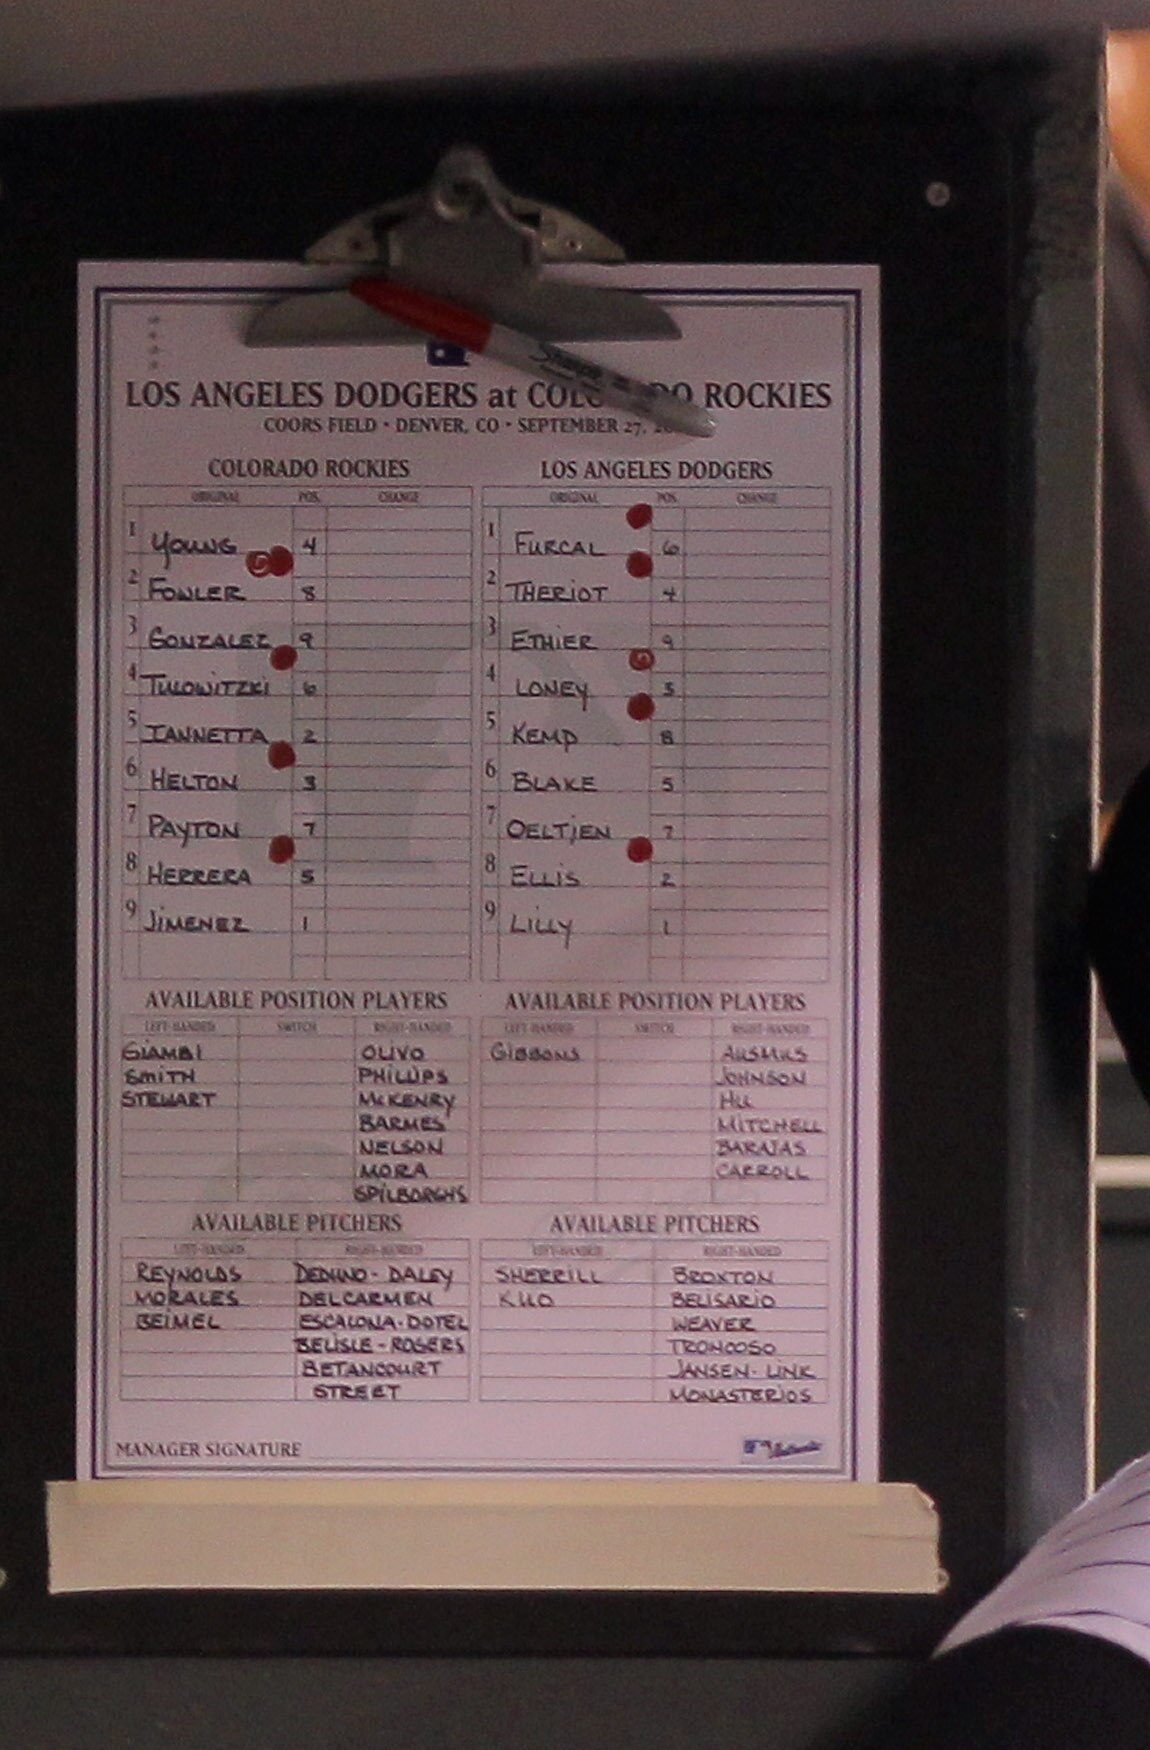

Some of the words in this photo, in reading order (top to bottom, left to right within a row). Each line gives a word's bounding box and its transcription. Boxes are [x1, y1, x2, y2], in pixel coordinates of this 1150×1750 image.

[126, 381, 180, 409] LOS
[190, 381, 325, 409] ANGELES
[334, 381, 479, 409] DODGERS
[488, 384, 518, 409] at
[527, 381, 694, 409] COLODO
[704, 381, 833, 410] ROCKIES
[264, 417, 323, 433] COORS
[328, 417, 378, 433] FIELD
[394, 417, 469, 436] DENVER,
[475, 418, 500, 434] CO
[518, 418, 619, 434] SEPTEMBER
[208, 458, 318, 479] COLORADO
[325, 458, 410, 479] ROCKIES
[540, 460, 578, 479] LOS
[583, 460, 671, 480] ANGELES
[678, 460, 773, 480] DODGERS
[128, 521, 137, 538] 1
[487, 521, 495, 538] 1
[151, 532, 239, 569] YOUNG
[302, 537, 317, 555] 4
[515, 531, 607, 555] FURCAL
[661, 540, 680, 556] 6
[127, 570, 139, 585] 2
[486, 571, 497, 585] 2
[148, 577, 246, 602] FOWLER
[301, 586, 316, 602] 8
[505, 579, 609, 602] THERIOT
[661, 586, 677, 602] 4
[128, 616, 138, 635] 3
[487, 617, 497, 635] 3
[148, 626, 271, 650] GONZALEZ
[299, 634, 314, 651] 9
[511, 625, 599, 650] ETHIER
[661, 634, 675, 650] 9
[127, 663, 138, 681] 4
[485, 663, 496, 682] 4
[303, 680, 317, 696] 6
[516, 678, 590, 712] LONEY
[127, 711, 138, 728] 5
[485, 711, 497, 729] 5
[140, 724, 271, 744] IANNETTA
[302, 729, 318, 744] 2
[511, 722, 579, 752] KEMP
[126, 758, 138, 777] 6
[484, 759, 496, 778] 6
[151, 768, 240, 791] HELTON
[302, 776, 317, 792] 3
[511, 771, 599, 792] BLAKE
[661, 777, 675, 792] 5
[126, 804, 137, 822] 7
[485, 805, 497, 823] 7
[148, 814, 241, 849] PAYTON
[302, 822, 317, 837] 7
[662, 825, 674, 840] 7
[125, 852, 137, 871] 8
[484, 853, 497, 872] 8
[148, 861, 251, 885] HERRERA
[301, 869, 316, 885] 5
[510, 863, 581, 887] ELLIS
[660, 871, 676, 887] 2
[125, 901, 137, 919] 9
[144, 907, 251, 932] JIMENEZ
[302, 916, 309, 932] 1
[484, 901, 497, 920] 9
[510, 906, 573, 950] LILLY
[662, 919, 670, 935] 1
[145, 990, 254, 1010] AVAILABLE
[260, 990, 356, 1010] POSITION
[363, 991, 448, 1011] PLAYERS
[505, 992, 612, 1012] AVAILABLE
[618, 992, 714, 1012] POSITION
[720, 992, 807, 1012] PLAYERS
[121, 1039, 203, 1061] GIAMBI
[361, 1040, 425, 1061] OLIVO
[124, 1064, 195, 1085] SMITH
[715, 1066, 807, 1087] JOHNSON
[121, 1091, 217, 1108] STEWART
[716, 1114, 824, 1134] MITCHELL
[359, 1137, 444, 1156] NELSON
[715, 1138, 807, 1157] BARAJAS
[359, 1162, 428, 1179] MORA
[715, 1163, 811, 1181] CARROLL
[192, 1213, 298, 1233] AVAILABLE
[306, 1213, 402, 1233] PITCHERS
[550, 1215, 657, 1234] AVAILABLE
[664, 1215, 760, 1234] PITCHERS
[136, 1262, 243, 1290] REYNOLDS
[495, 1265, 604, 1285] SHERRILL
[671, 1265, 774, 1285] BROXTON
[134, 1290, 241, 1307] MORALES
[299, 1290, 433, 1308] DELCARMEN
[670, 1290, 777, 1309] BELISARIO
[135, 1308, 221, 1331] BEIMEL
[671, 1314, 757, 1332] WEAVER
[292, 1333, 374, 1354] BELISLE
[302, 1360, 443, 1378] BETANCOURT
[766, 1359, 817, 1380] LINK
[312, 1383, 403, 1401] STREET
[669, 1385, 813, 1404] MONASTERIOS
[114, 1441, 200, 1459] MANAGER
[205, 1441, 302, 1459] SIGNATURE
